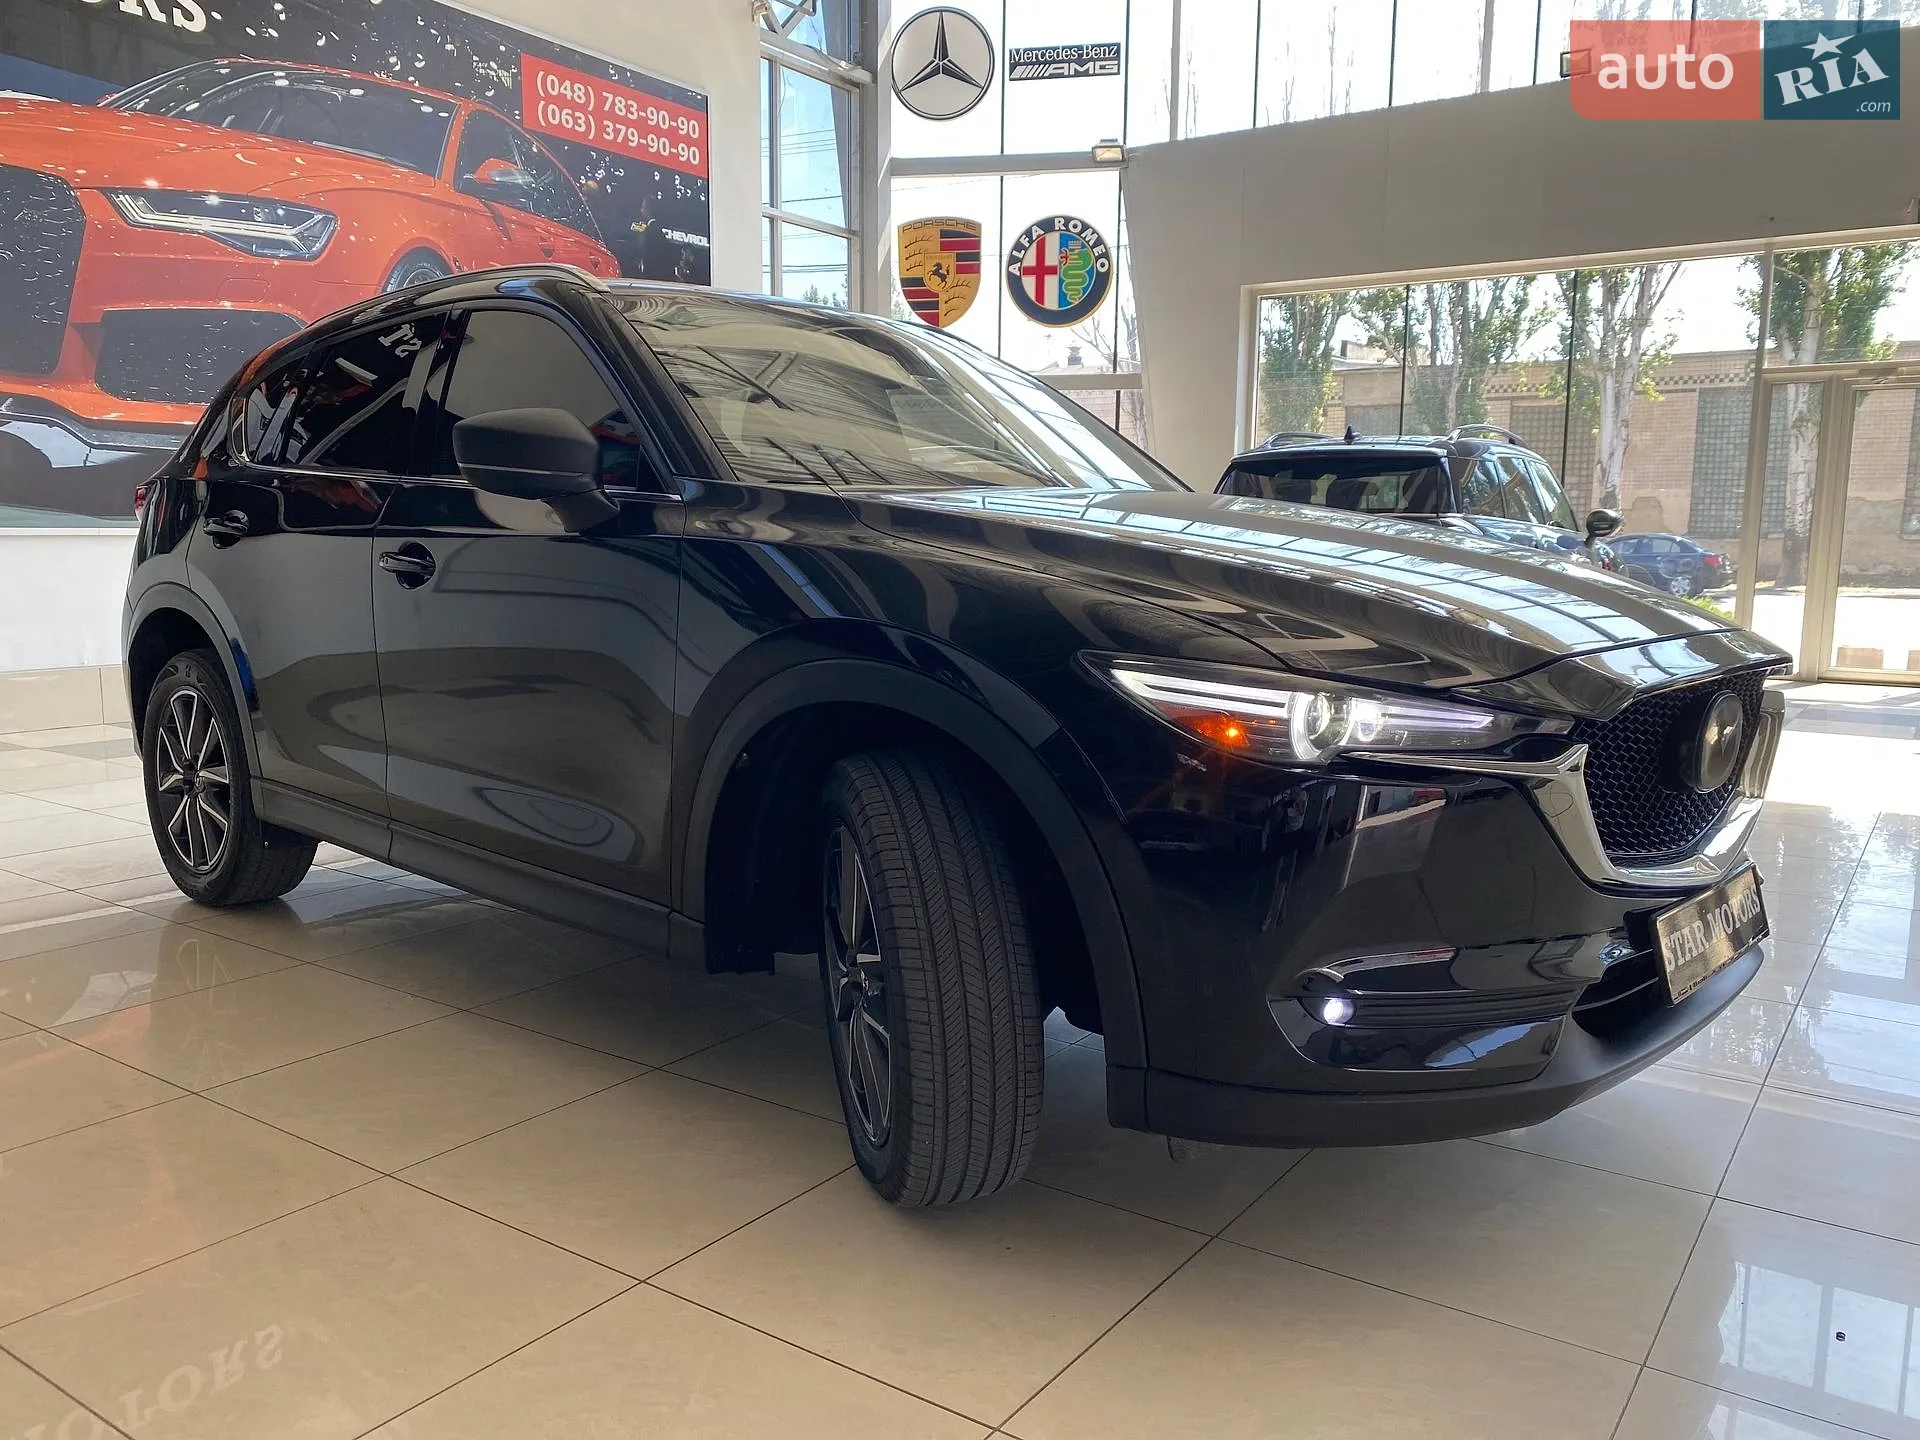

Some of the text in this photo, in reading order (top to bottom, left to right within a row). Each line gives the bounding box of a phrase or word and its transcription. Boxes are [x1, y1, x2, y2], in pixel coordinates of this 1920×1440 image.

[1010, 43, 1118, 63] Mercedes-Benz
[536, 70, 700, 139] (048) 783-90-90
[537, 100, 700, 165] (063) 379-90-90
[902, 218, 978, 233] PORSCHE
[1008, 217, 1110, 277] ALFA ROMEO
[1663, 886, 1761, 973] STAR MOTORS
